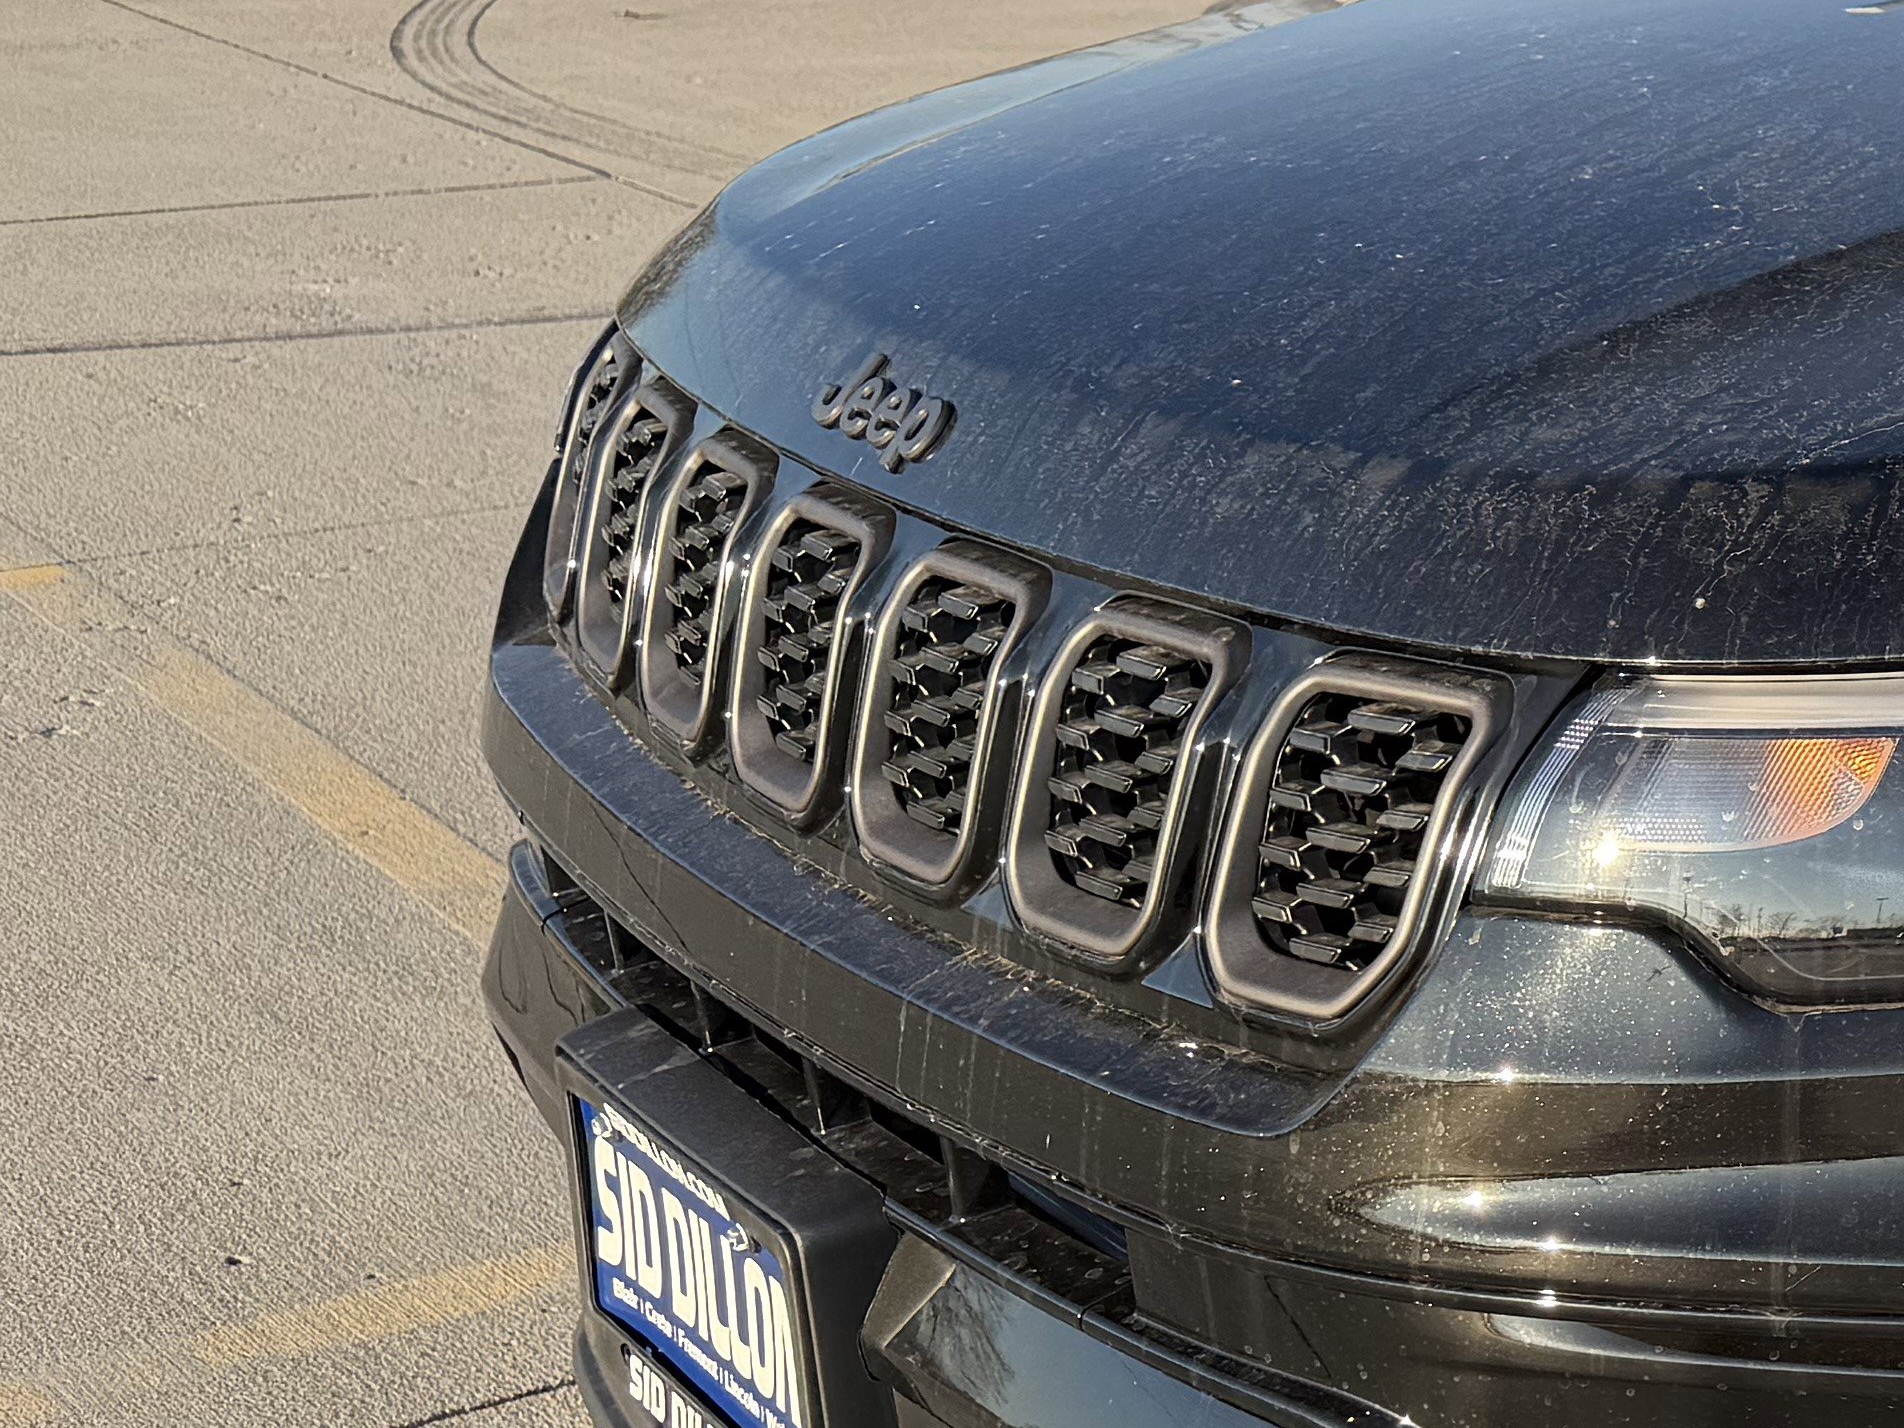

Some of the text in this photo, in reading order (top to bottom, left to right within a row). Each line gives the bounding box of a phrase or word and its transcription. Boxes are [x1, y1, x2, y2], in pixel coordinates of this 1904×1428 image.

[811, 353, 956, 474] Jeep
[594, 1135, 663, 1299] SID
[629, 1353, 666, 1424] SID
